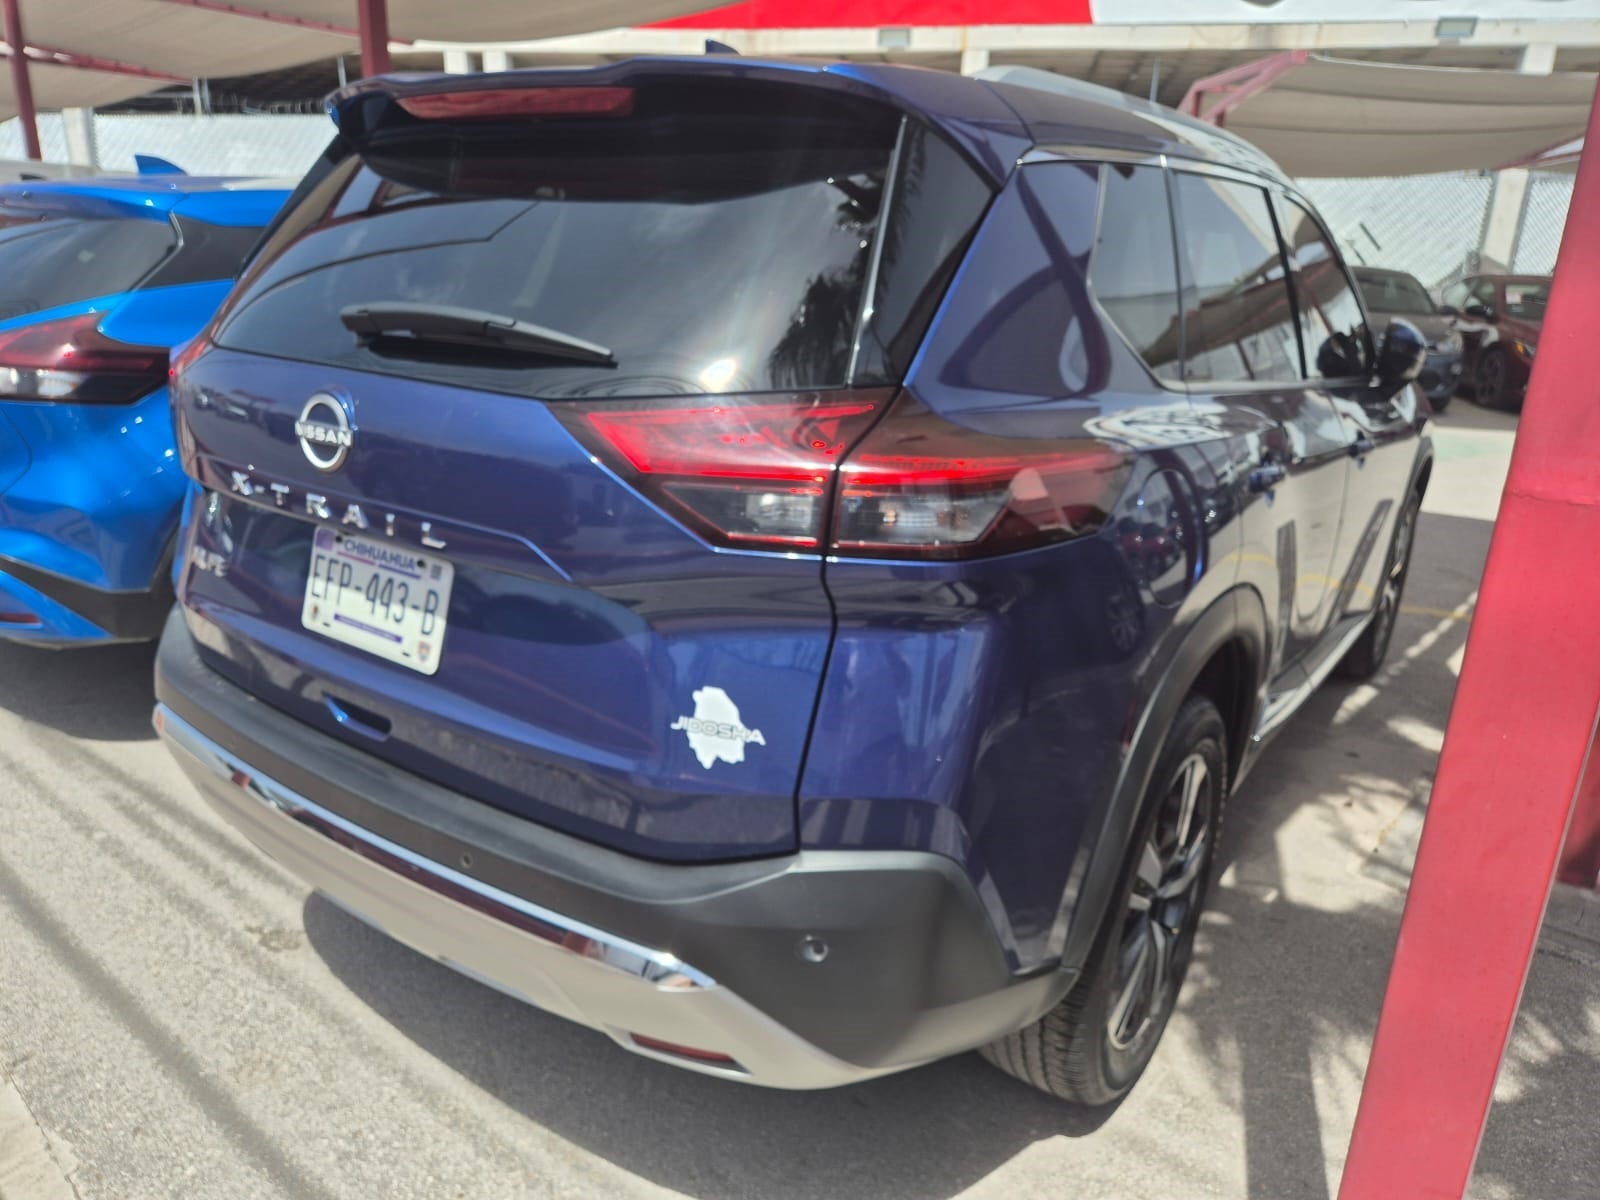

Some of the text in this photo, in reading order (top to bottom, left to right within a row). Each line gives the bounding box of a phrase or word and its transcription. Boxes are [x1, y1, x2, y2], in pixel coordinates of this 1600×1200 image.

[295, 421, 352, 447] NISSAN
[231, 471, 447, 549] X-TRAIL
[344, 540, 416, 571] CHIHUAHUA
[311, 554, 440, 636] EFP-443-B
[670, 716, 766, 746] JIDOSHA
